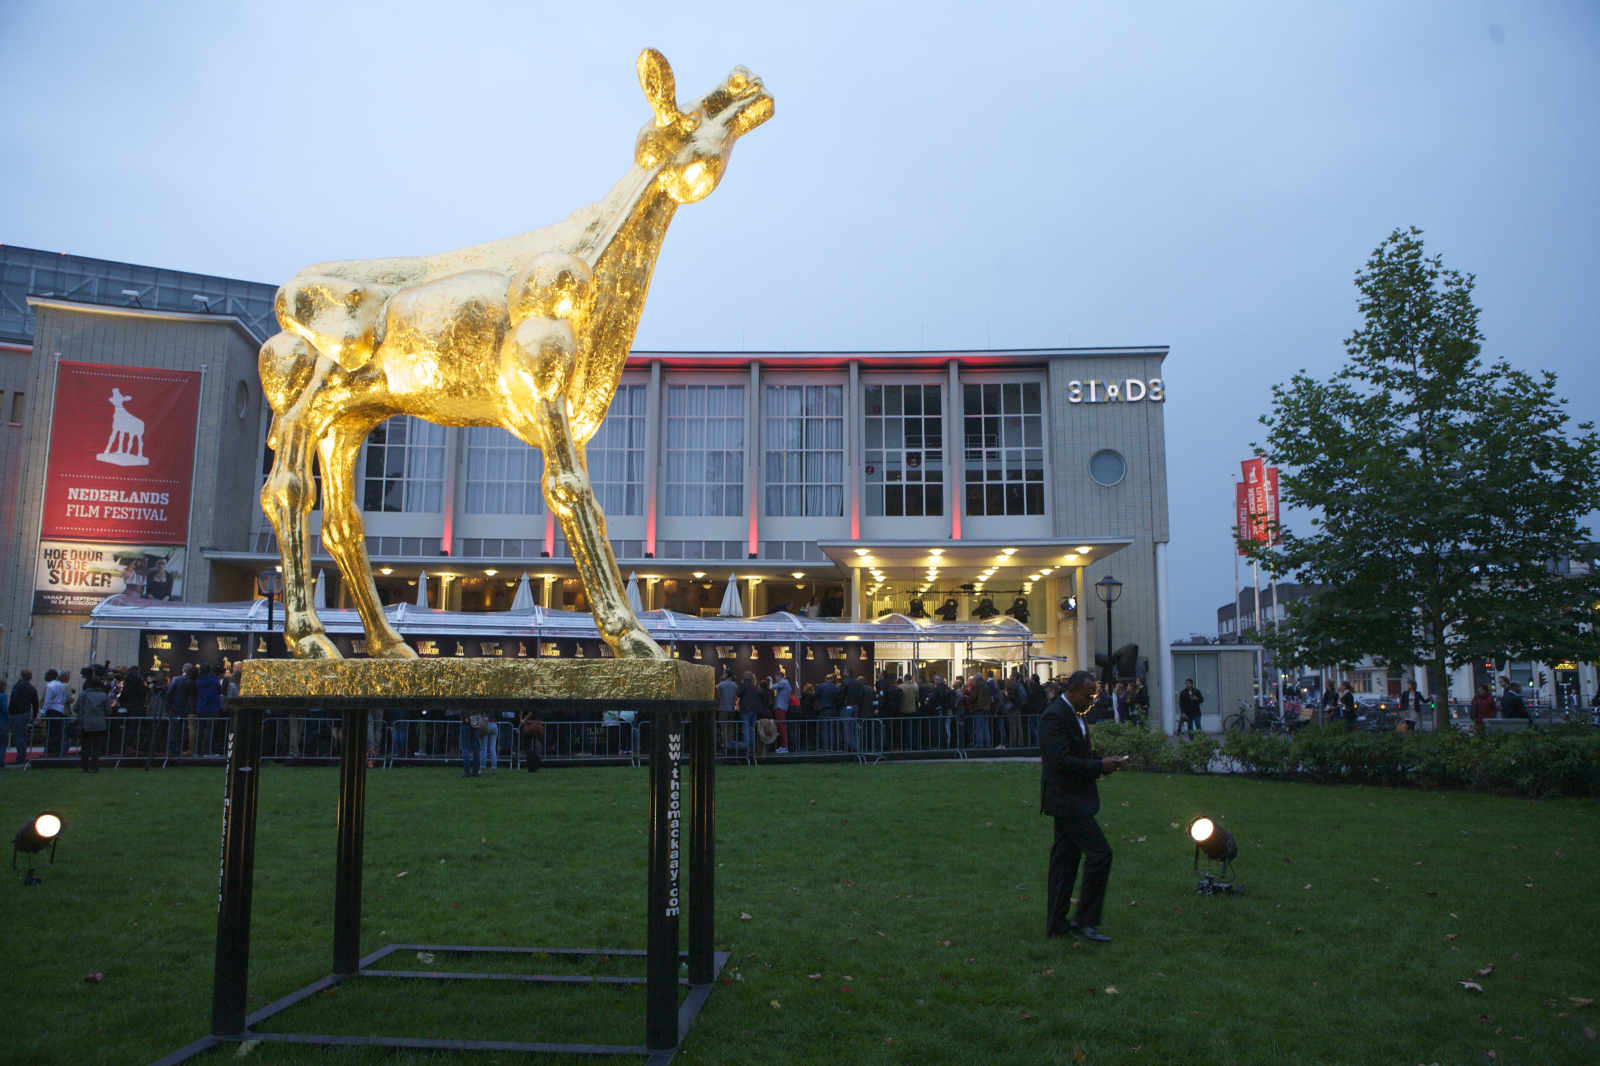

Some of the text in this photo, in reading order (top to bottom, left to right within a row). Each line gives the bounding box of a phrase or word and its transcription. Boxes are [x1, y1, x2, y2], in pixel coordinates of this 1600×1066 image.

[68, 488, 170, 505] NEDERLANDS
[66, 504, 168, 522] FILM FESTIVAL
[44, 548, 104, 562] HOE DUUR
[47, 560, 87, 570] WAS DE
[48, 570, 112, 588] SUIKER
[666, 734, 681, 917] www.theomackaay.com
